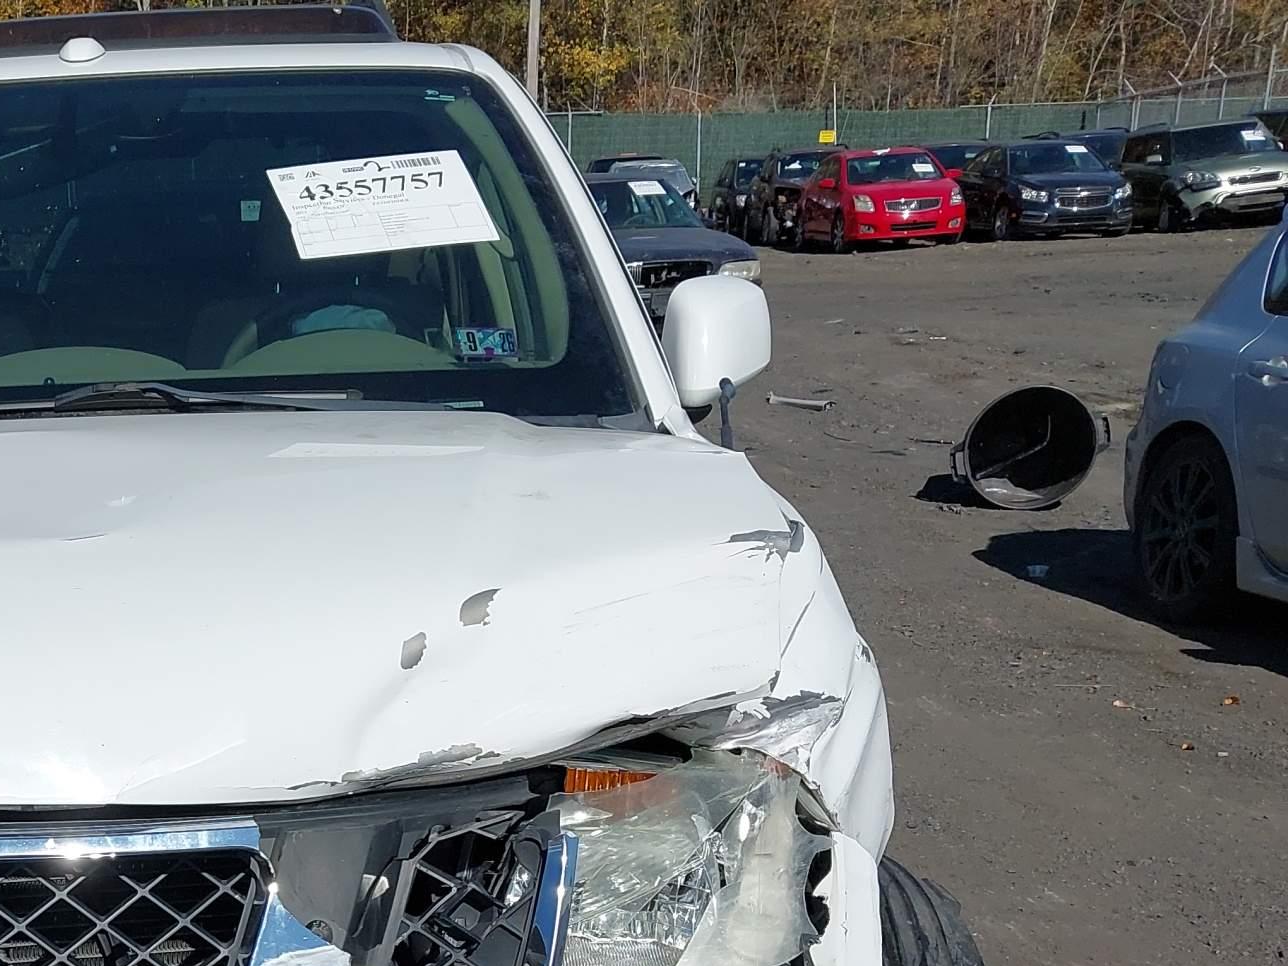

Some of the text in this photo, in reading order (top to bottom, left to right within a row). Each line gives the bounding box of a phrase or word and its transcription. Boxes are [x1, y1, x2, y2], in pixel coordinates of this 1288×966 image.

[299, 171, 443, 201] 43557757
[466, 331, 515, 353] 9 26
